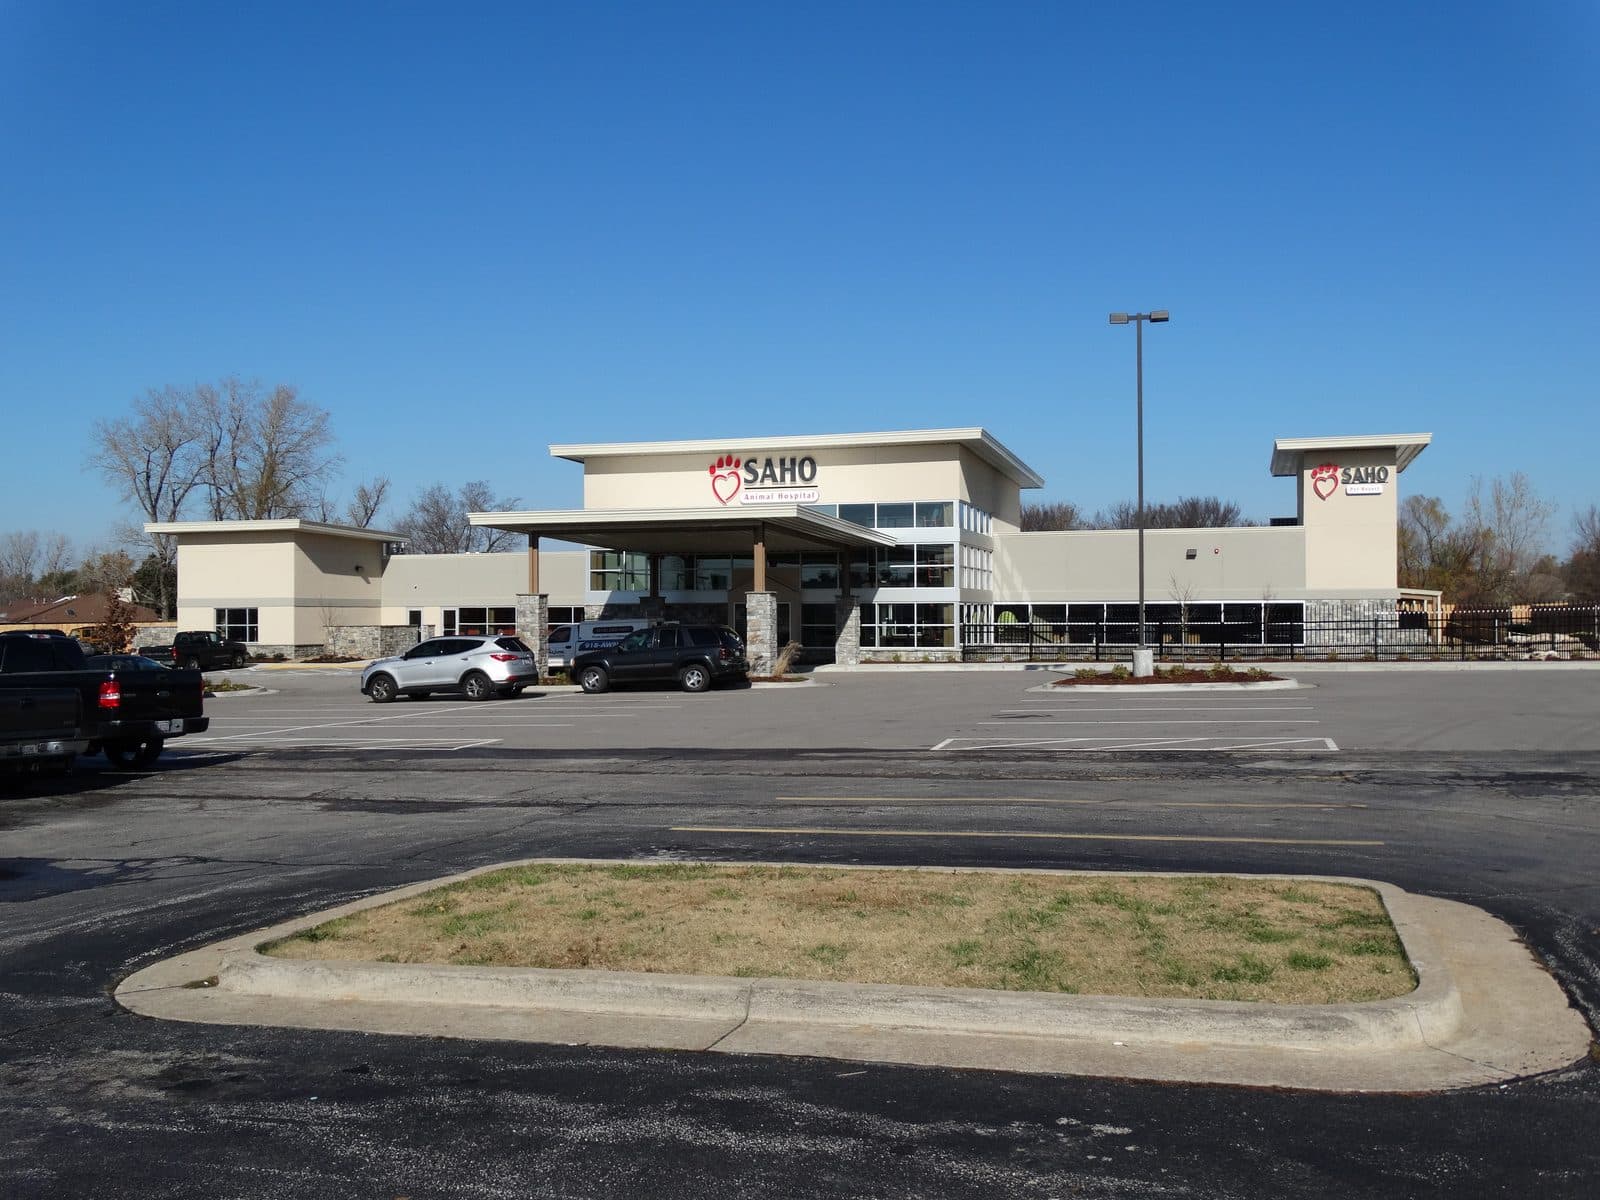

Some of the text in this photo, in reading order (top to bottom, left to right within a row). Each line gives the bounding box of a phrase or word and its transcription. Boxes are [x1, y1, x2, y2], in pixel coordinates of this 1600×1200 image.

[743, 456, 817, 484] SAHO
[1341, 466, 1389, 483] SAHO
[744, 491, 815, 501] Animal Hospital
